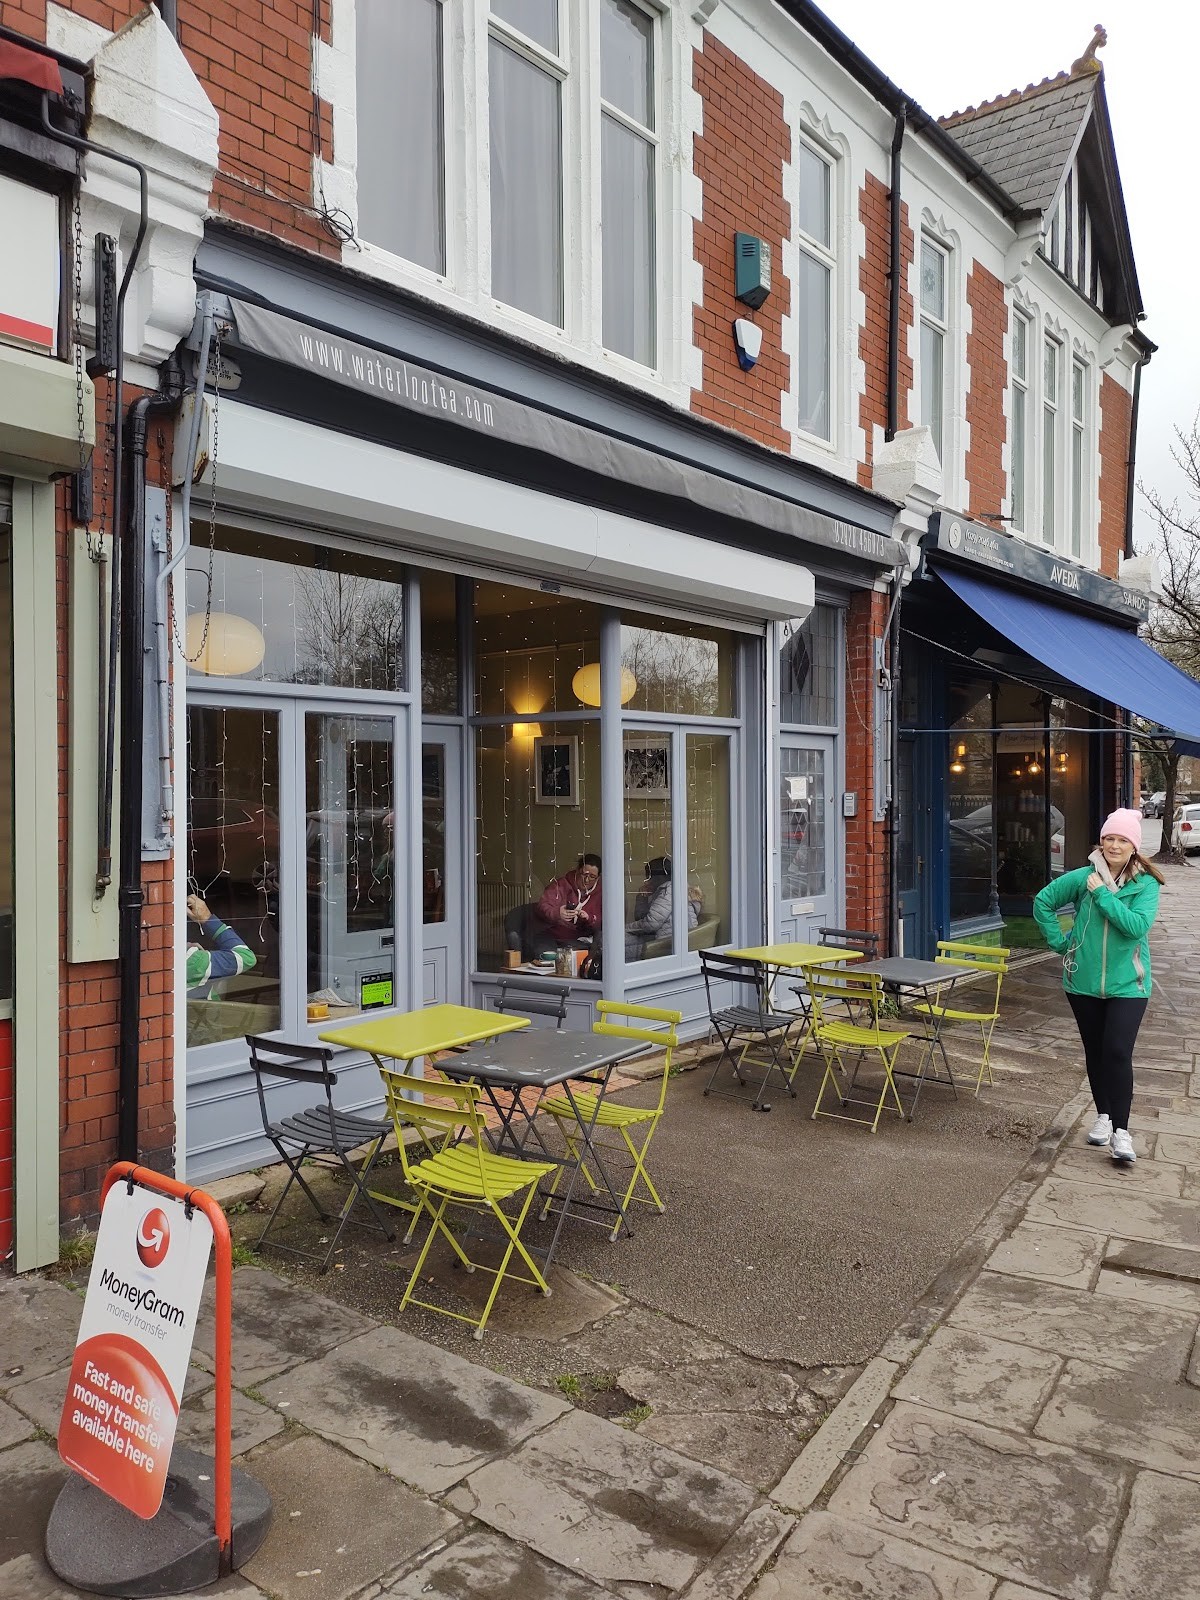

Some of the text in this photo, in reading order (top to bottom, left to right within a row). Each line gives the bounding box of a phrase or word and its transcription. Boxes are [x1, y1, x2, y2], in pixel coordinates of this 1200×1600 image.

[300, 335, 494, 427] www.waterlootea.com
[1050, 564, 1079, 591] AVEDA
[1123, 592, 1146, 611] SANDS
[100, 1268, 185, 1327] MoneyGram
[106, 1303, 167, 1341] money transfer
[73, 1383, 163, 1450] money transfer
[84, 1360, 161, 1421] Fast and safe
[72, 1409, 124, 1454] available
[125, 1437, 154, 1473] here
